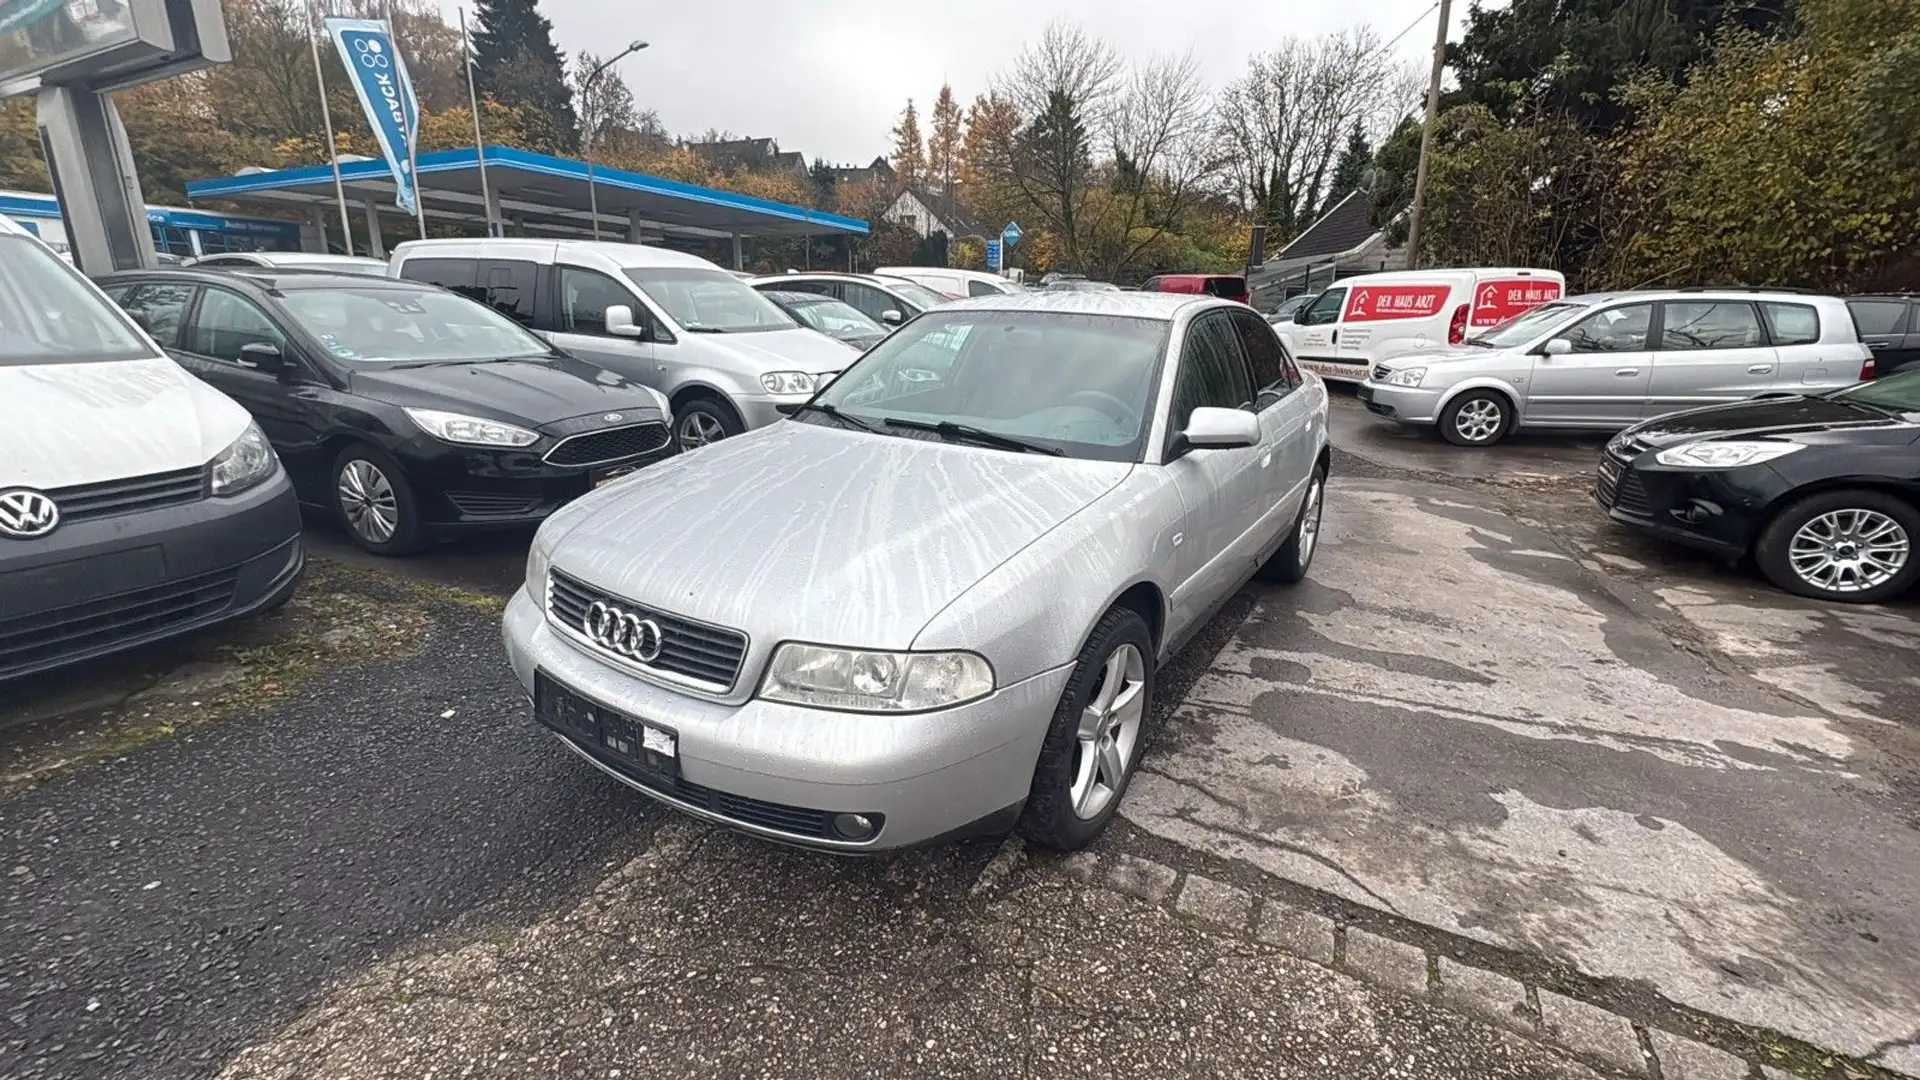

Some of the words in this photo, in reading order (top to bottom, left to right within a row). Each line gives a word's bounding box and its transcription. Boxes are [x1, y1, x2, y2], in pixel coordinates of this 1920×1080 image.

[1376, 294, 1392, 307] DER
[1393, 294, 1414, 308] HAUS
[1415, 294, 1437, 309] ARZT
[1507, 289, 1522, 301] DER
[1525, 289, 1541, 300] HAUS
[1543, 289, 1558, 300] ARZT
